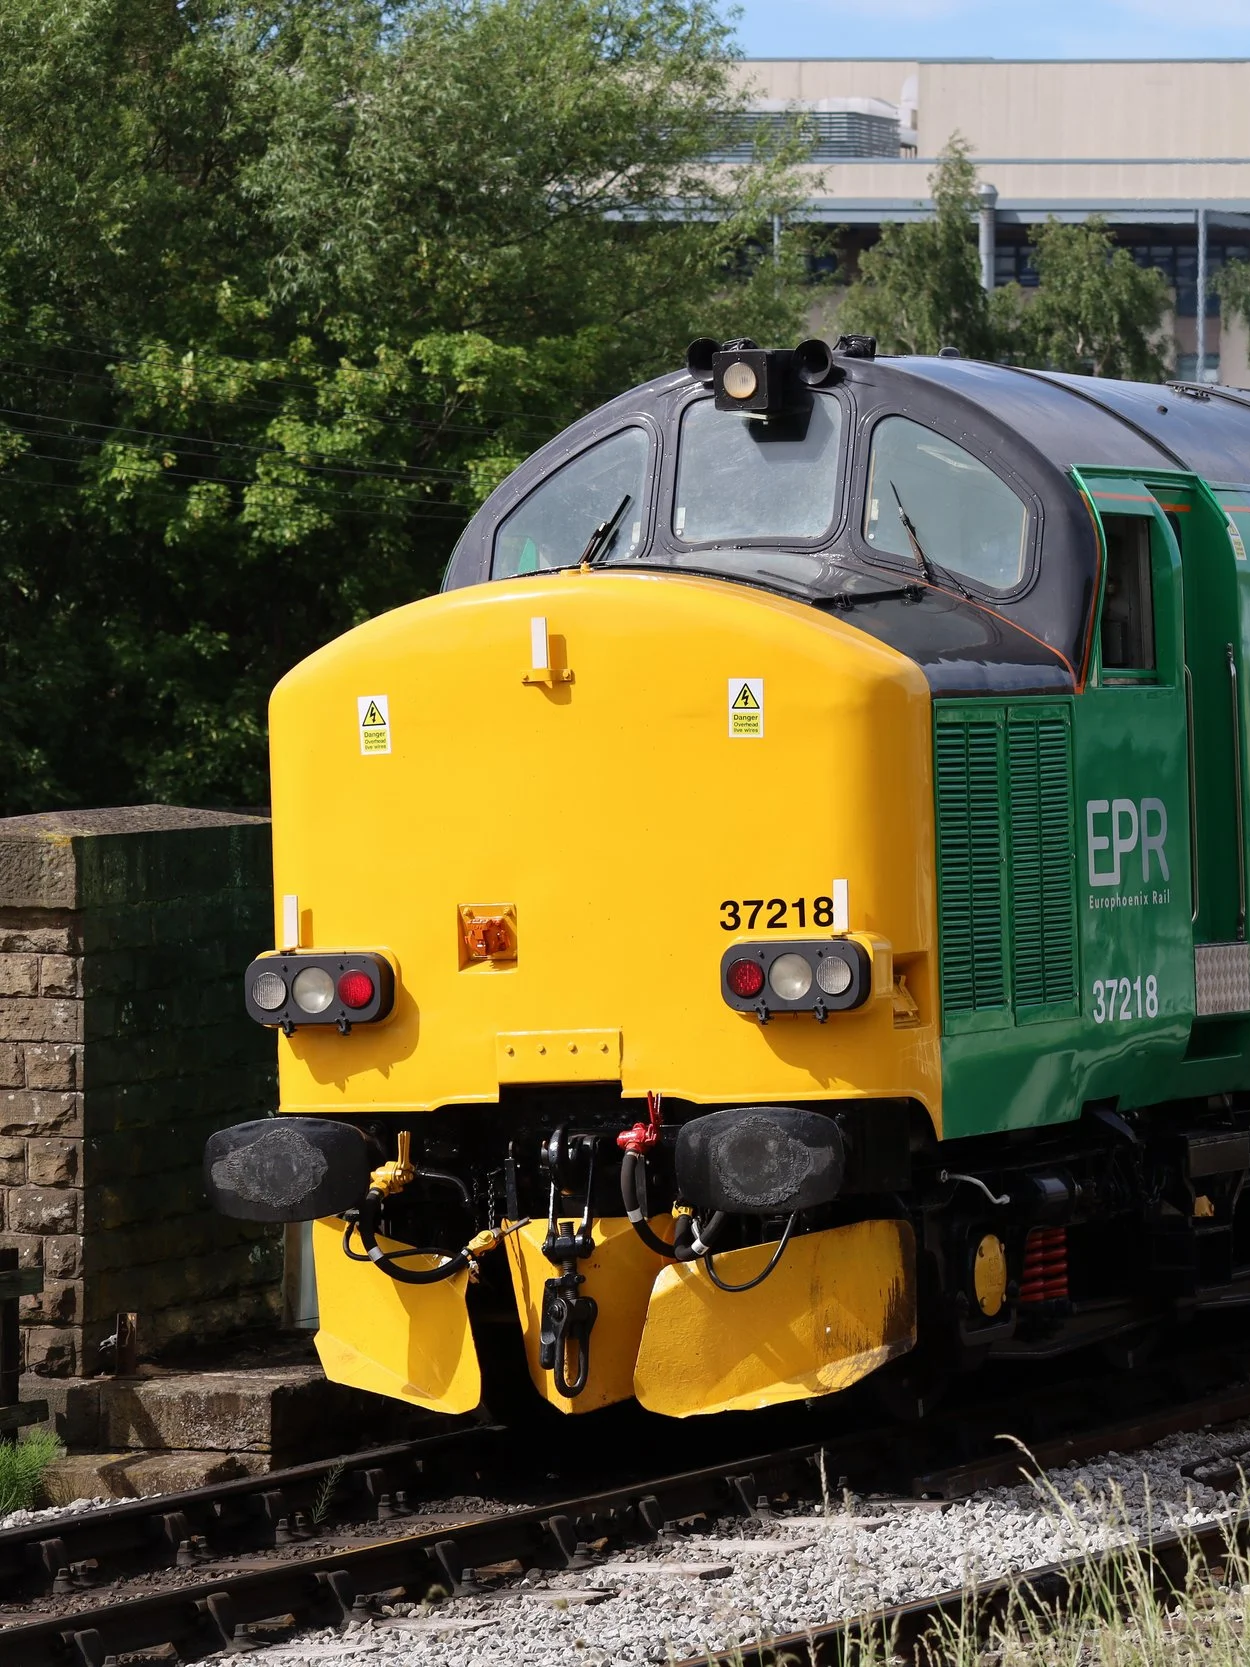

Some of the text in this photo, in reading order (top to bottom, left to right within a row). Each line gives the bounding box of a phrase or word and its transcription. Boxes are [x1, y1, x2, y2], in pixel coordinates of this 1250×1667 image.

[733, 714, 759, 722] Danger
[1086, 797, 1170, 887] EPR
[719, 896, 834, 931] 37218
[1089, 889, 1170, 912] Europhoenix Rail
[1092, 974, 1159, 1024] 37218
